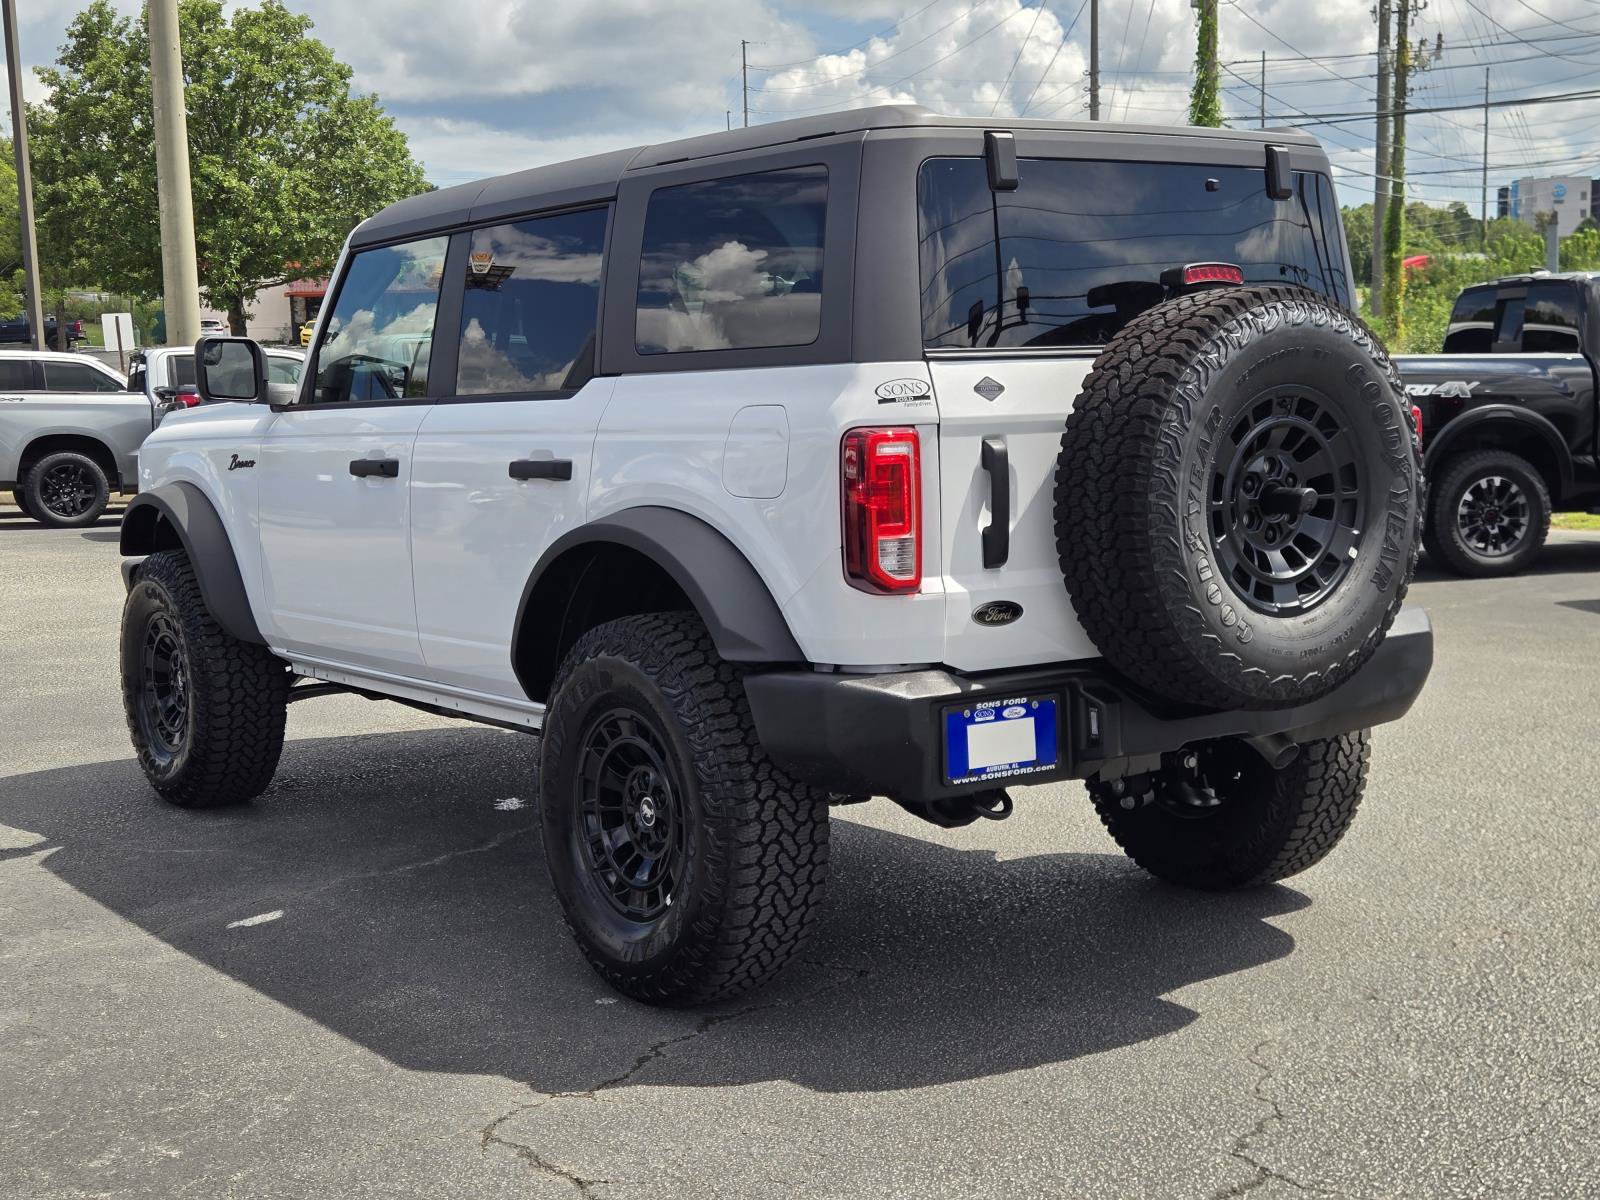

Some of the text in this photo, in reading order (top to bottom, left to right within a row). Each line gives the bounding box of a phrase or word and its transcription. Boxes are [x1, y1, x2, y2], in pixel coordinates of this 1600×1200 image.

[883, 382, 923, 397] SONS
[228, 454, 256, 471] Bronco
[986, 607, 1012, 621] Ford
[976, 697, 1027, 709] SONS FORD
[953, 764, 1055, 784] www.SONSFORD.com
[986, 764, 1011, 773] AUBURN,
